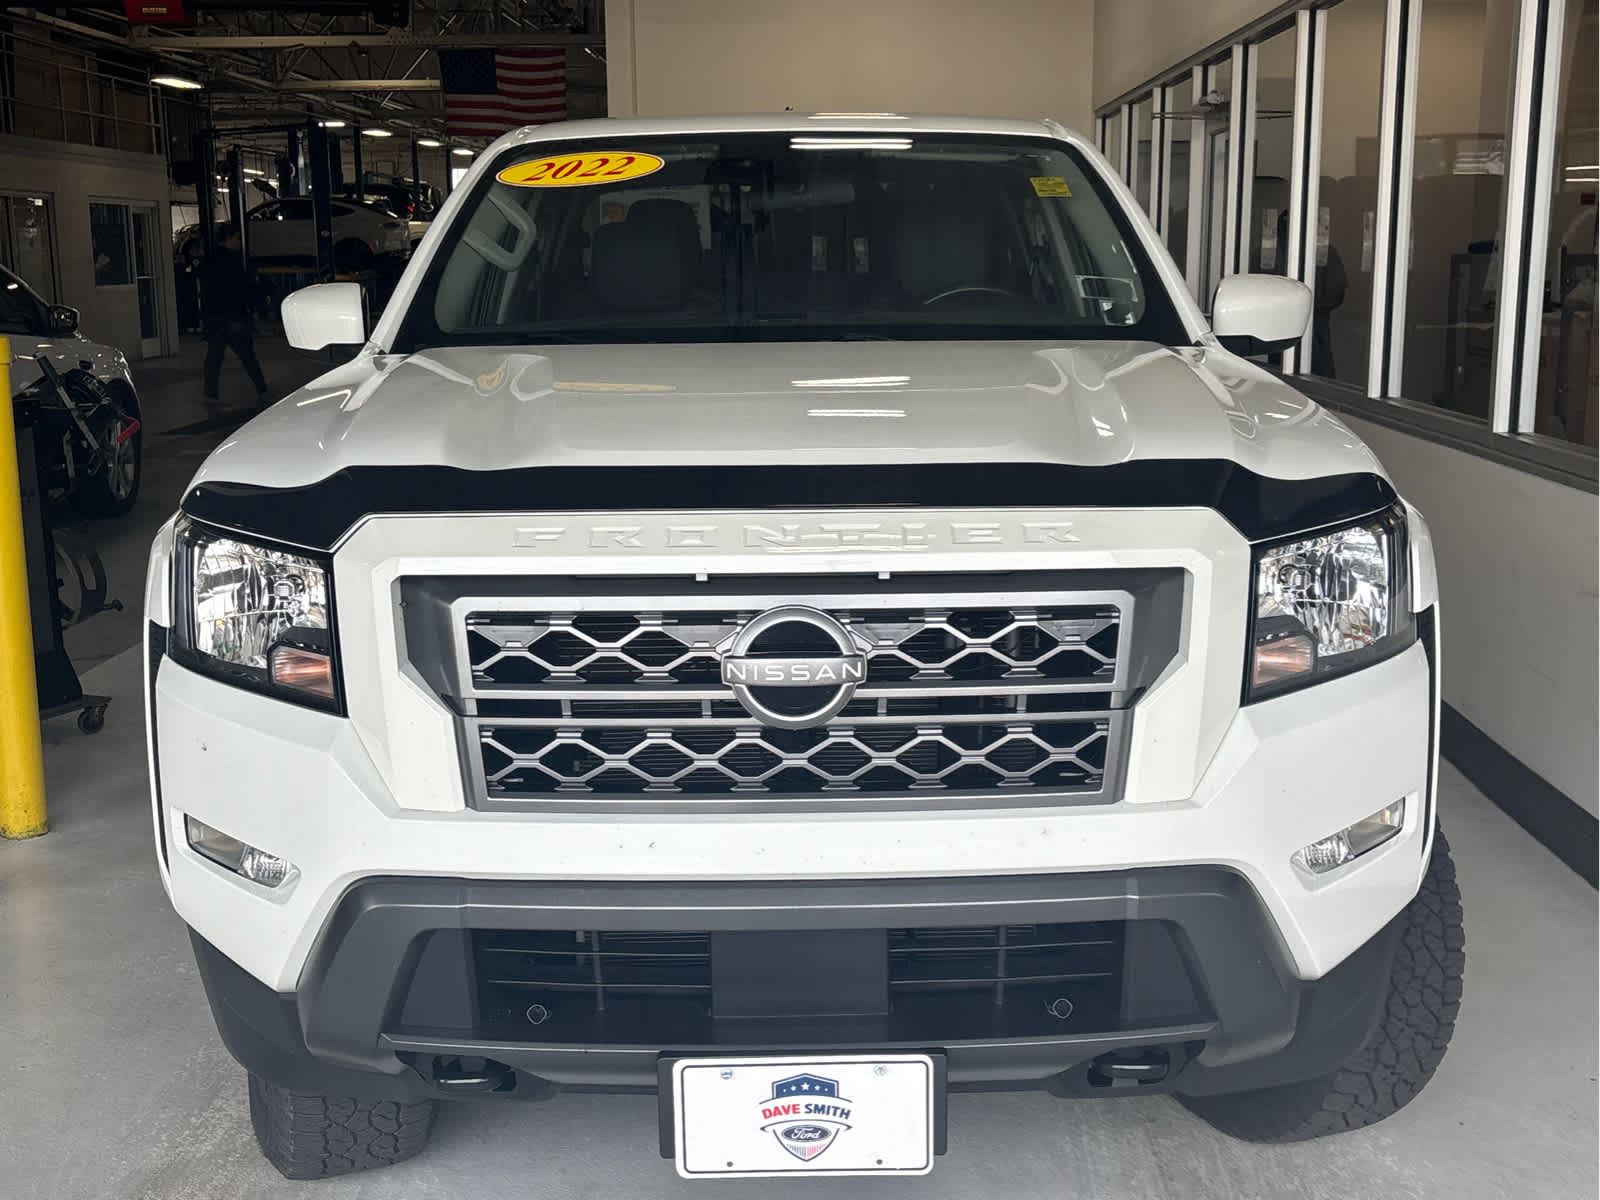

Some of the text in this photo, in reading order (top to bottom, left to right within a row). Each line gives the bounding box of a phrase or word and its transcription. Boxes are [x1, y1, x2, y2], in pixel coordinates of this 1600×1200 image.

[521, 156, 636, 182] 2022
[512, 523, 1081, 548] FRONTIER
[726, 661, 862, 681] NISSAN
[761, 1103, 851, 1120] DAVE SMITH
[791, 1128, 821, 1140] Ford
